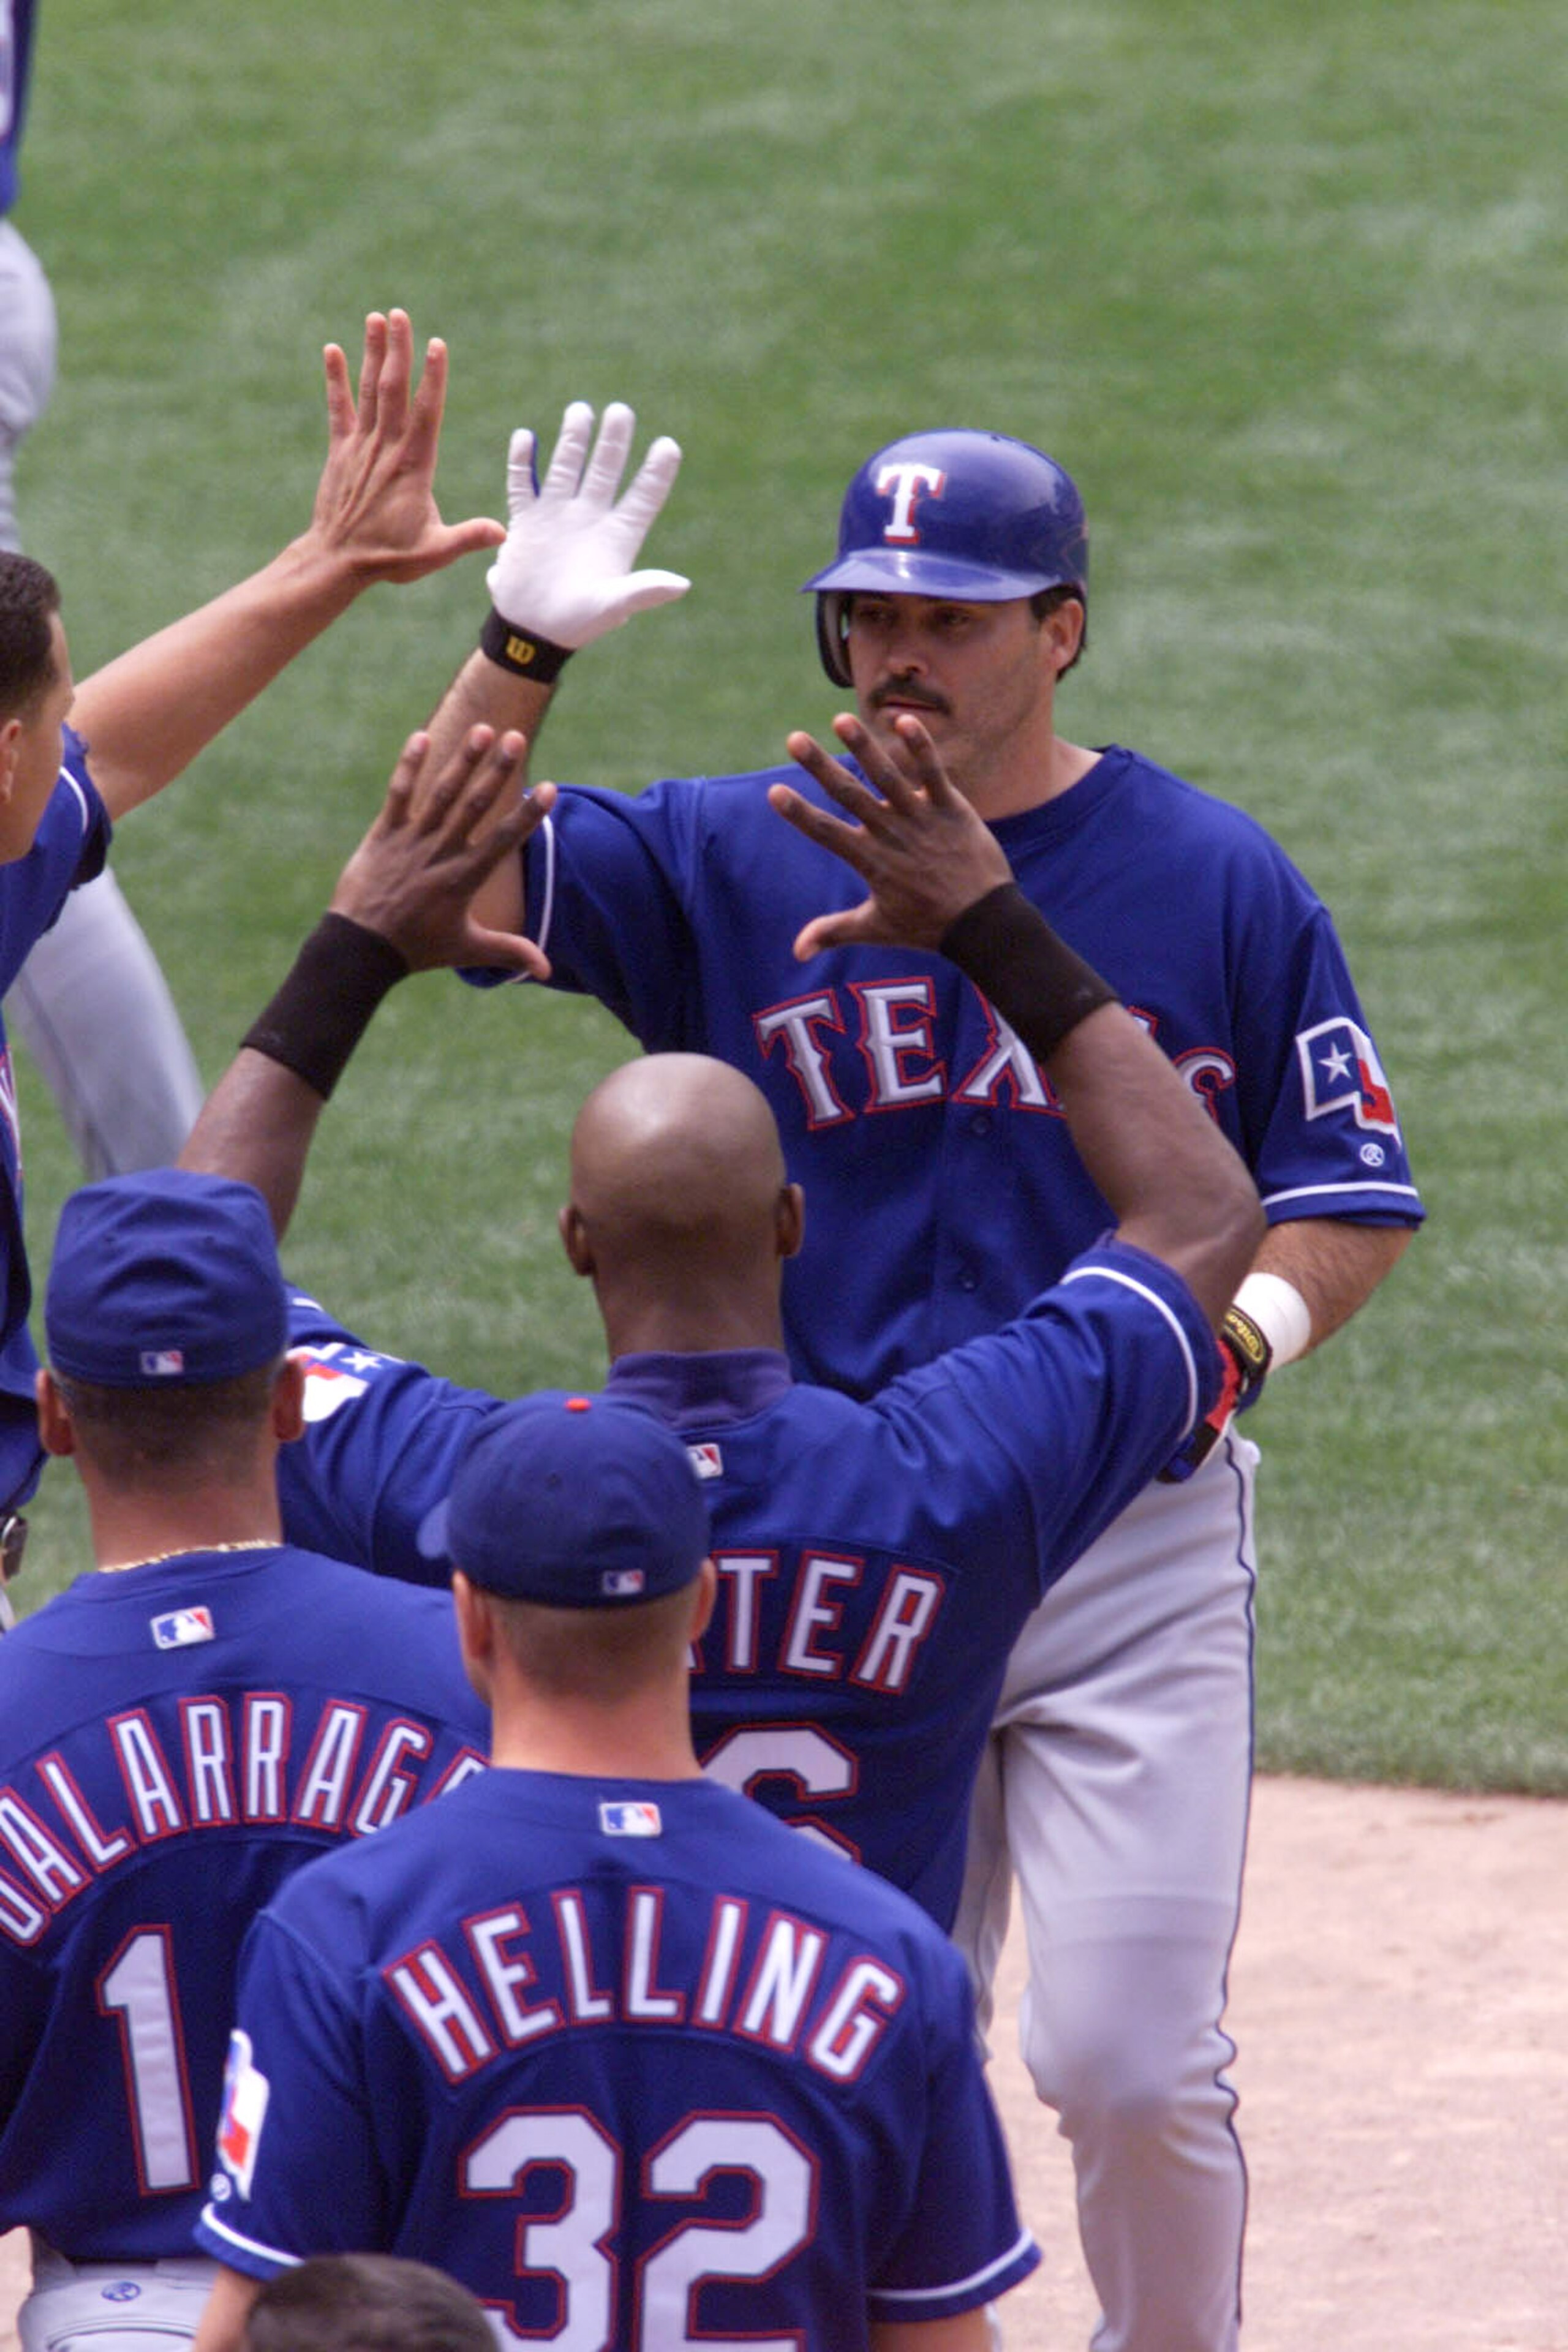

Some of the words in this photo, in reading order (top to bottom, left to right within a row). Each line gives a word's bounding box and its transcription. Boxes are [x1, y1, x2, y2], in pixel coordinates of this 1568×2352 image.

[876, 462, 947, 545] T
[688, 1550, 945, 1694] TER
[383, 1886, 905, 2082] HELLING
[458, 2105, 820, 2352] 32
